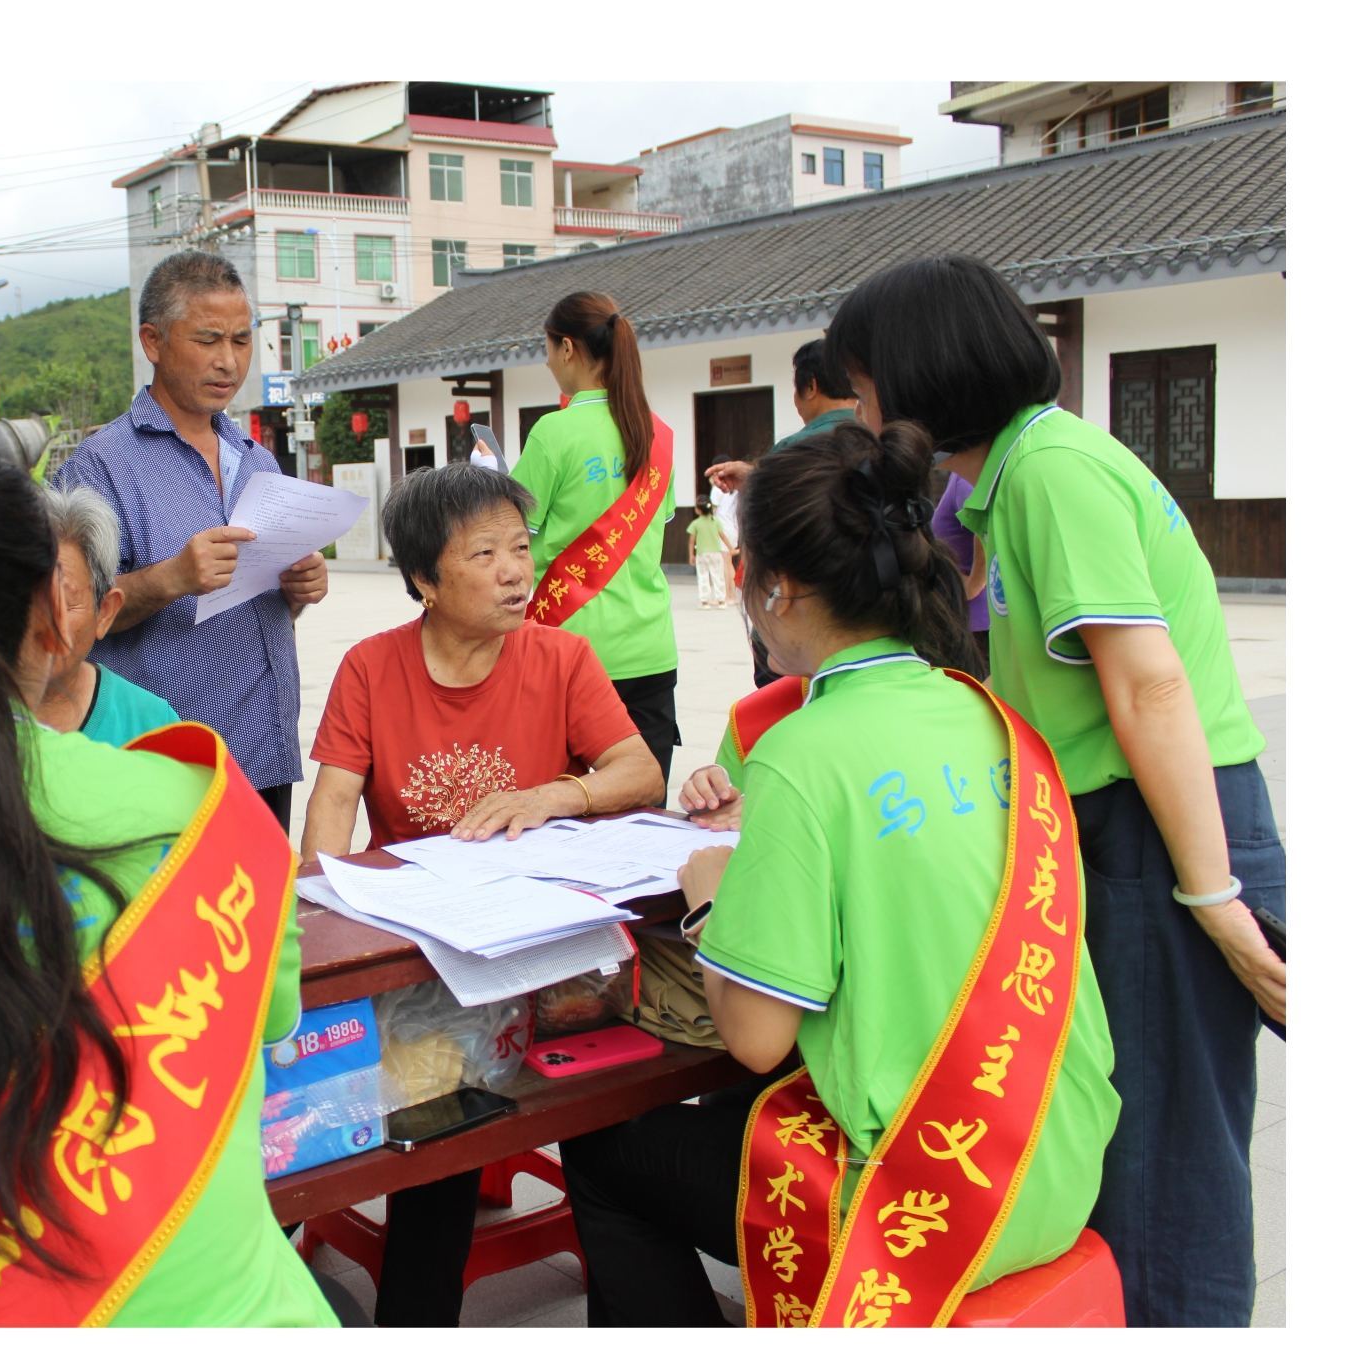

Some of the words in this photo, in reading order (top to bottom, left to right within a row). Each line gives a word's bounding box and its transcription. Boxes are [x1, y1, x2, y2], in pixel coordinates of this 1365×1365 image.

[325, 1018, 359, 1042] 1980
[297, 1031, 320, 1056] 18
[843, 772, 1066, 1327] 马克思主义学院
